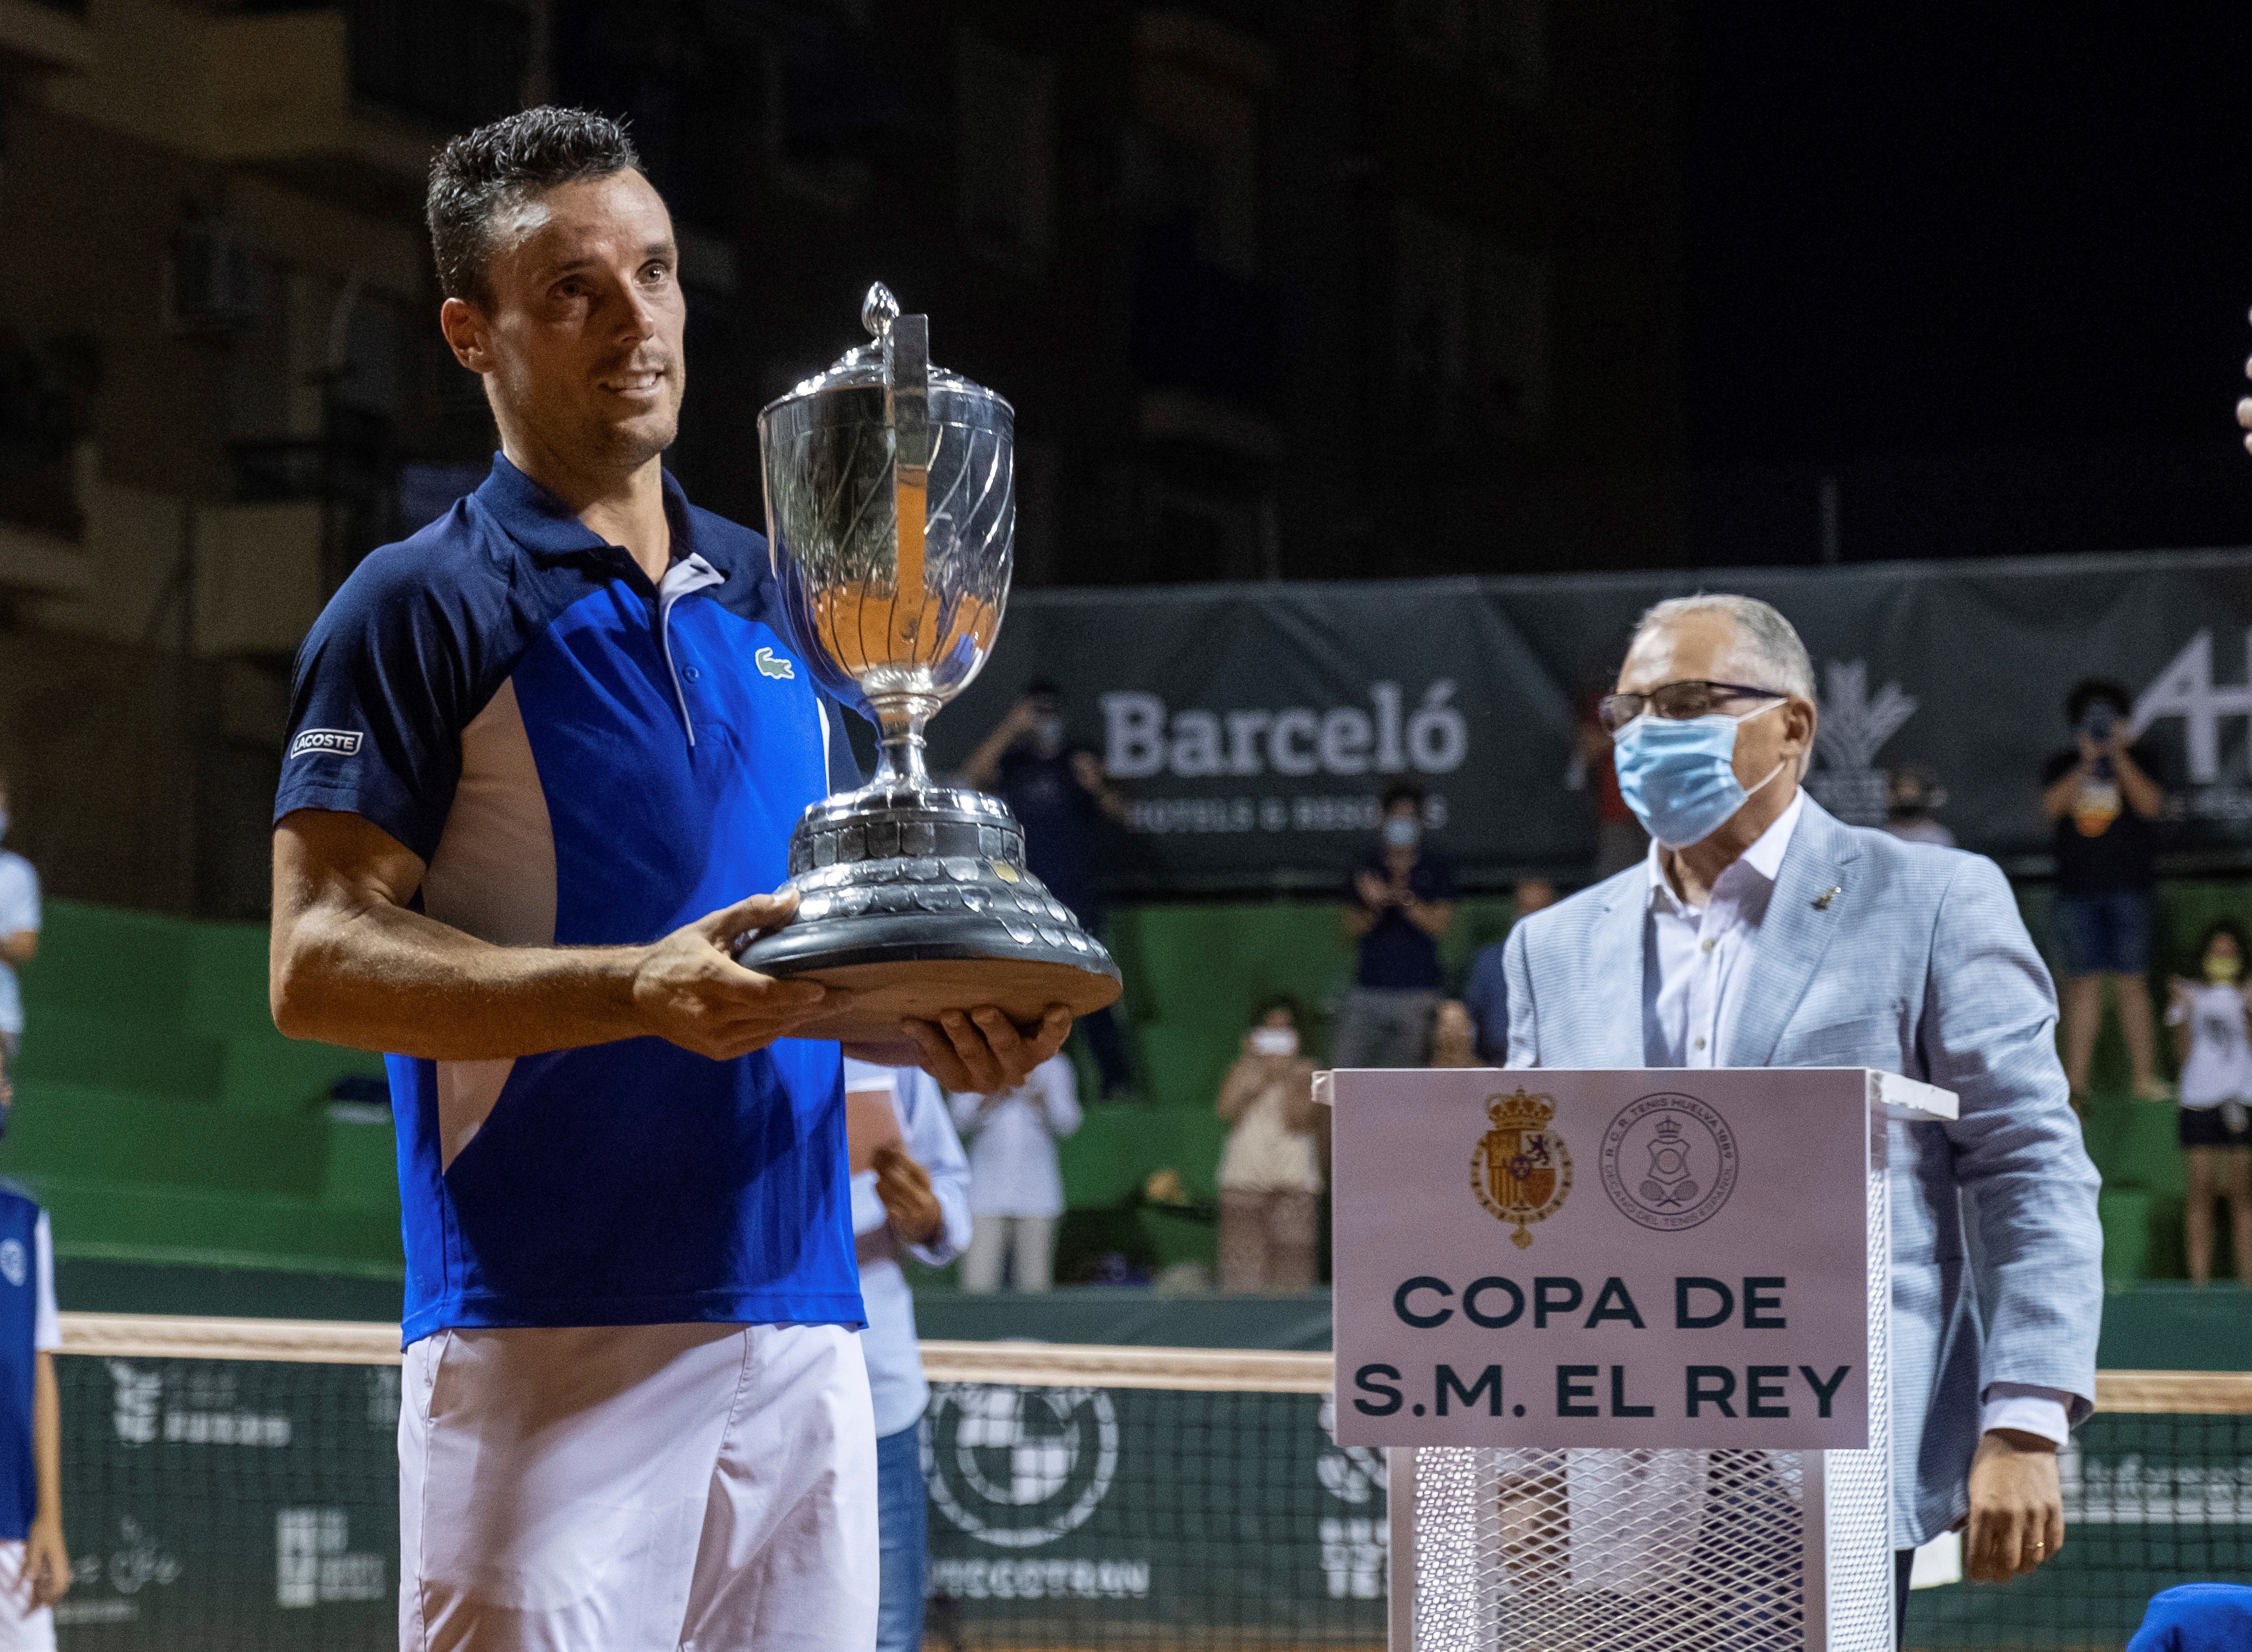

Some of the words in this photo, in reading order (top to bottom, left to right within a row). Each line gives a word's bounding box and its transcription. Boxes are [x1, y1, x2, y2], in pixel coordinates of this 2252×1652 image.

[294, 734, 355, 752] LACOSTE
[1098, 679, 1468, 778] Barceló
[1630, 1098, 1668, 1117] TENIS
[1671, 1098, 1720, 1129] HUELVA
[1393, 1275, 1646, 1329] COPA
[1674, 1276, 1787, 1329] DE
[1353, 1363, 1526, 1418] S.M.
[1556, 1364, 1655, 1418] EL
[1685, 1364, 1851, 1418] REY
